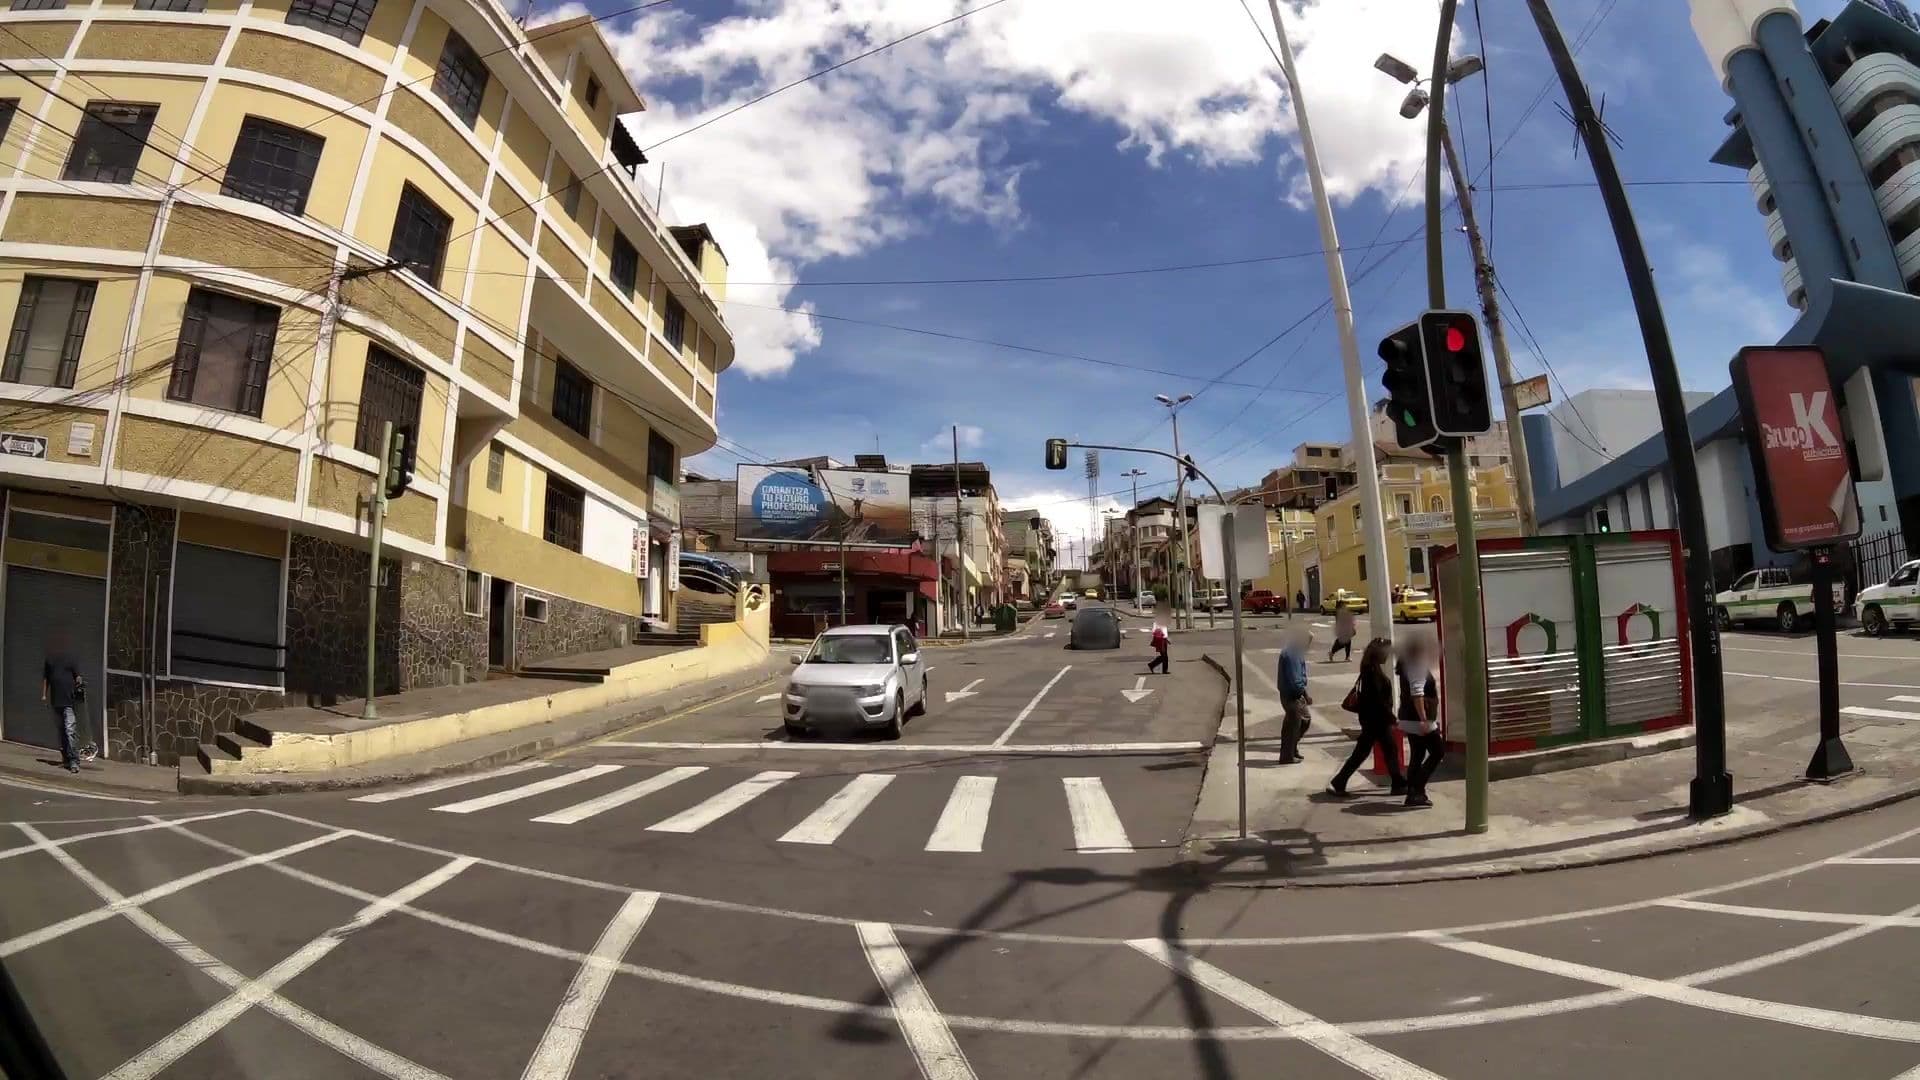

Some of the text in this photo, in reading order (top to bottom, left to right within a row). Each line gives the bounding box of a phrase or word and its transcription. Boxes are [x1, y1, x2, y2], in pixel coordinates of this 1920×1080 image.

[1761, 422, 1810, 450] Grupo
[762, 493, 809, 504] TU FUTURO
[761, 501, 820, 513] PROFESIONAL
